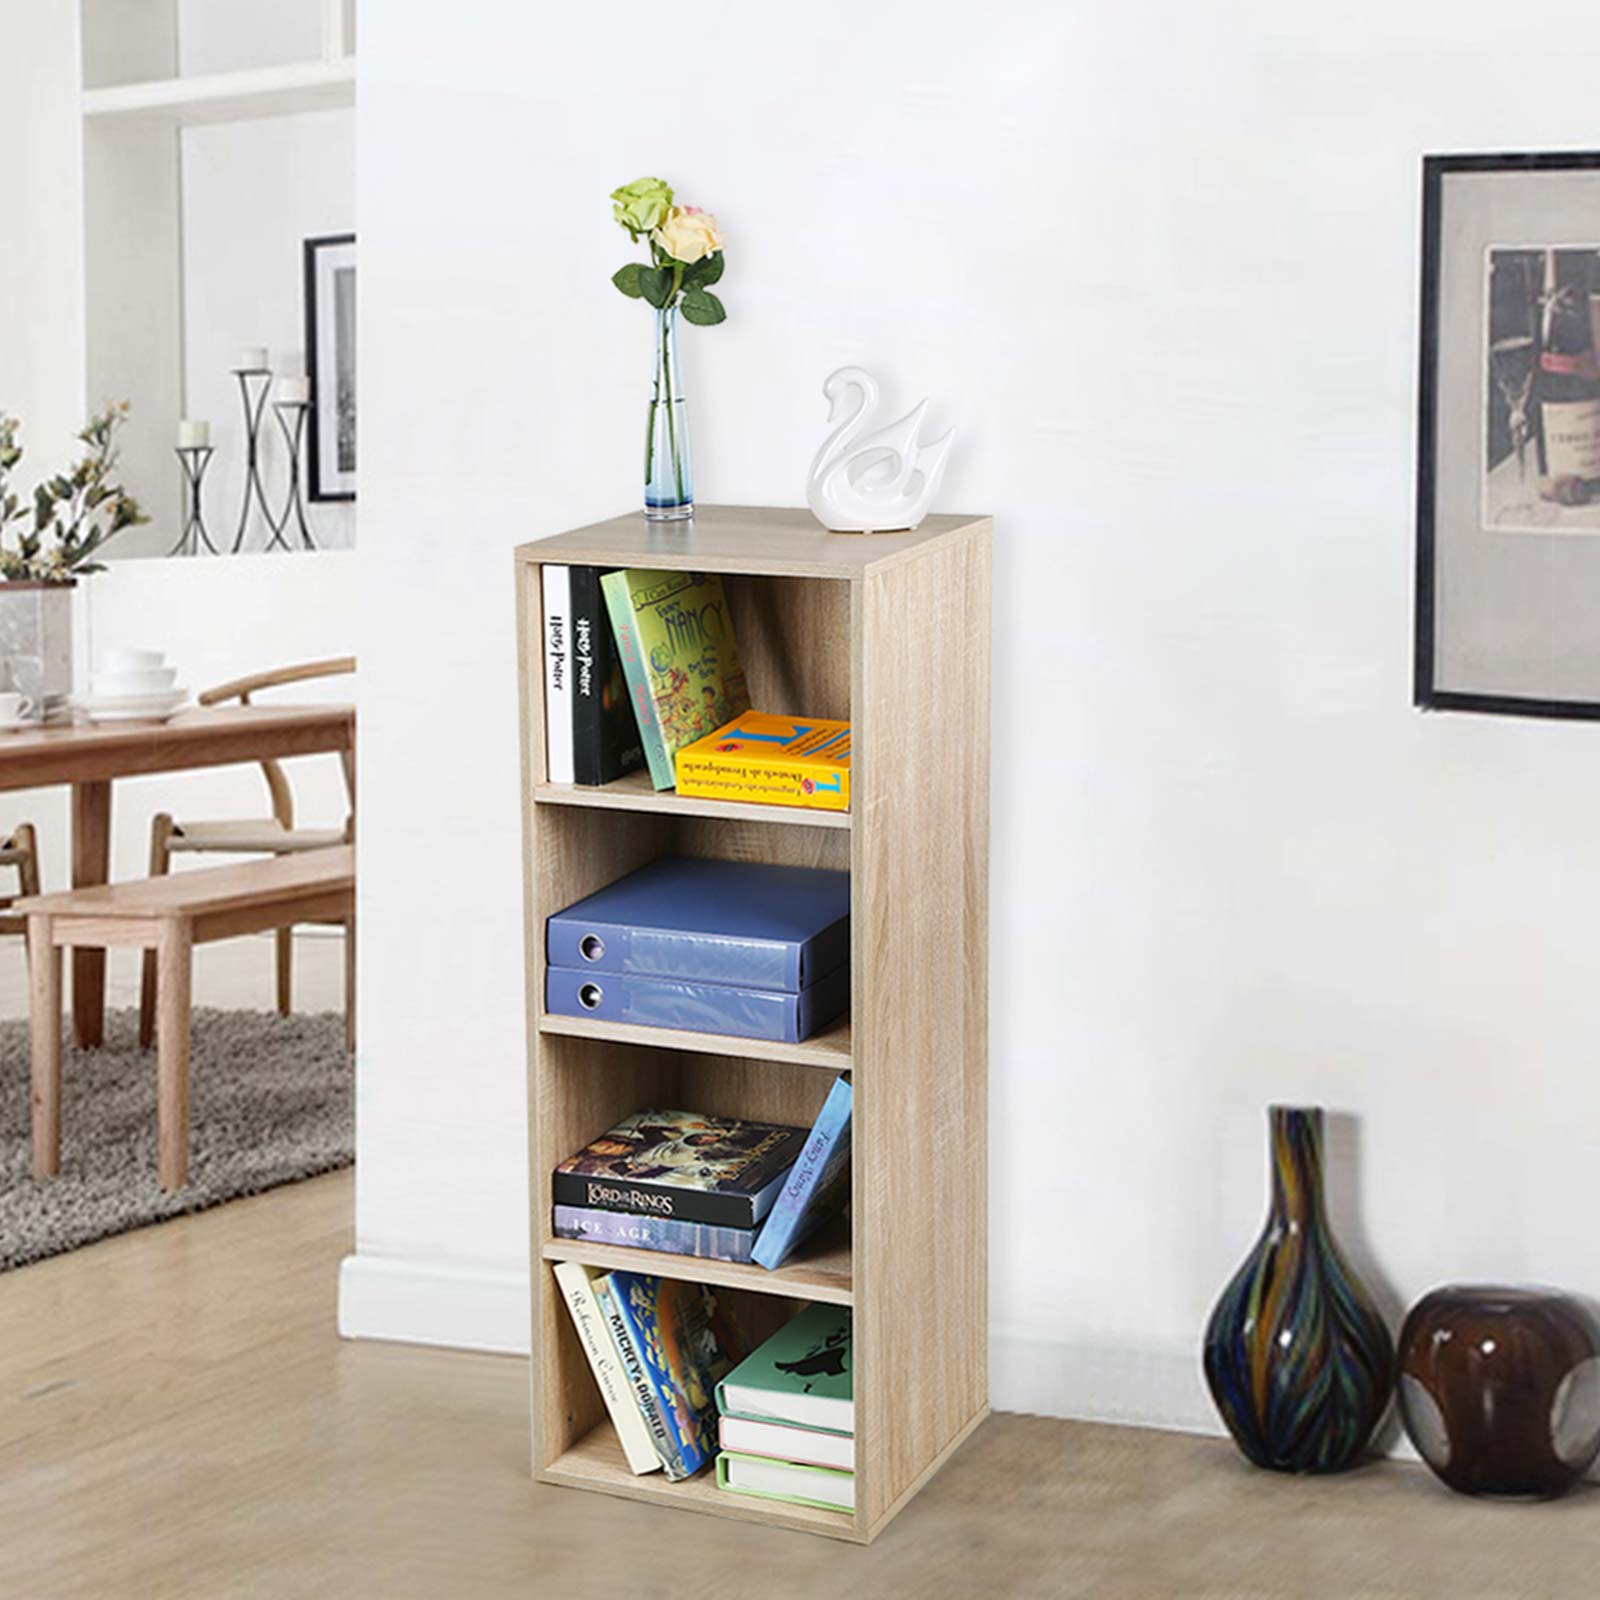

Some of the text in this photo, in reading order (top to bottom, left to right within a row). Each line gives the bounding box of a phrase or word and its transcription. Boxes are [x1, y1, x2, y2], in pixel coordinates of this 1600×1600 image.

[550, 615, 565, 690] Harry Potter
[665, 600, 726, 656] NANCY
[576, 617, 592, 696] Harry Potter
[805, 1131, 831, 1164] Fancy
[587, 1183, 621, 1205] LORD
[630, 1190, 674, 1215] RINGS
[573, 1219, 651, 1240] ICE AGE
[570, 1290, 599, 1355] Robinson
